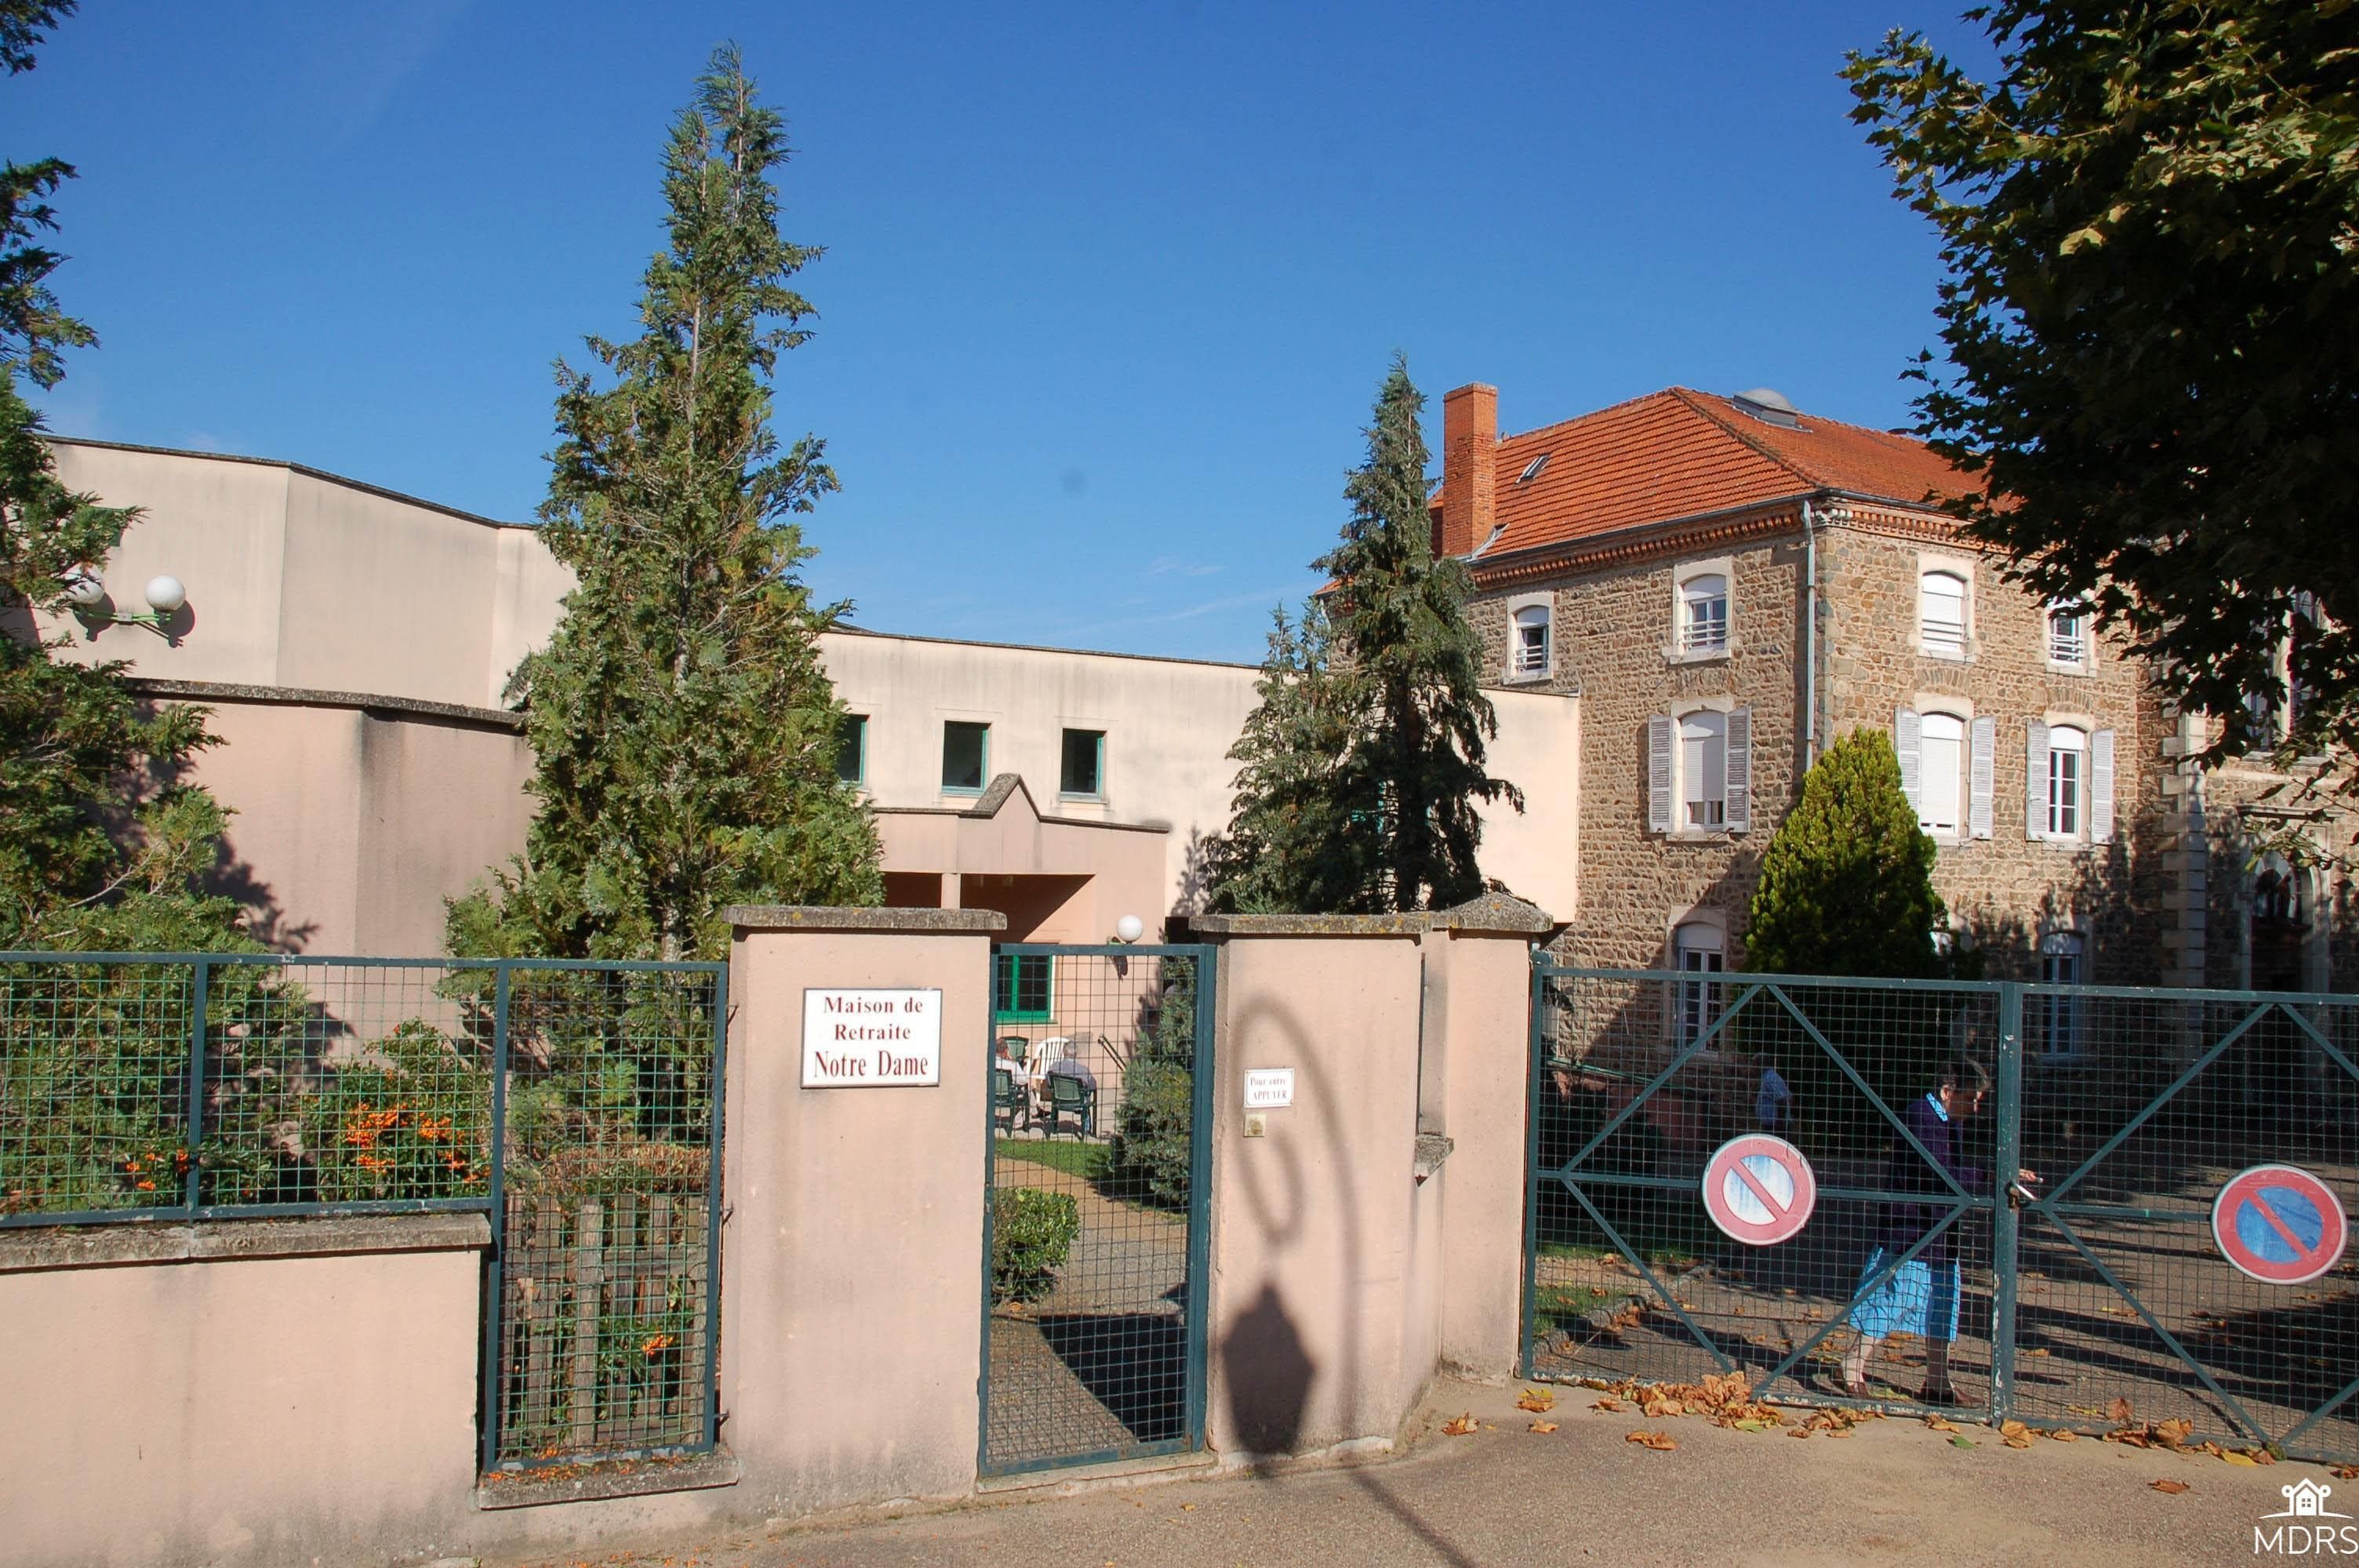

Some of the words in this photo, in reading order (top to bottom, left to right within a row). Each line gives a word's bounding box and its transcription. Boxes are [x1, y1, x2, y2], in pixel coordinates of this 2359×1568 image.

[823, 996, 893, 1014] Maison
[904, 996, 923, 1013] de
[834, 1023, 911, 1040] Retraite
[813, 1051, 867, 1078] Notre
[878, 1050, 929, 1076] Dame
[1250, 1077, 1266, 1086] Pour
[1254, 1090, 1287, 1100] APPUYER
